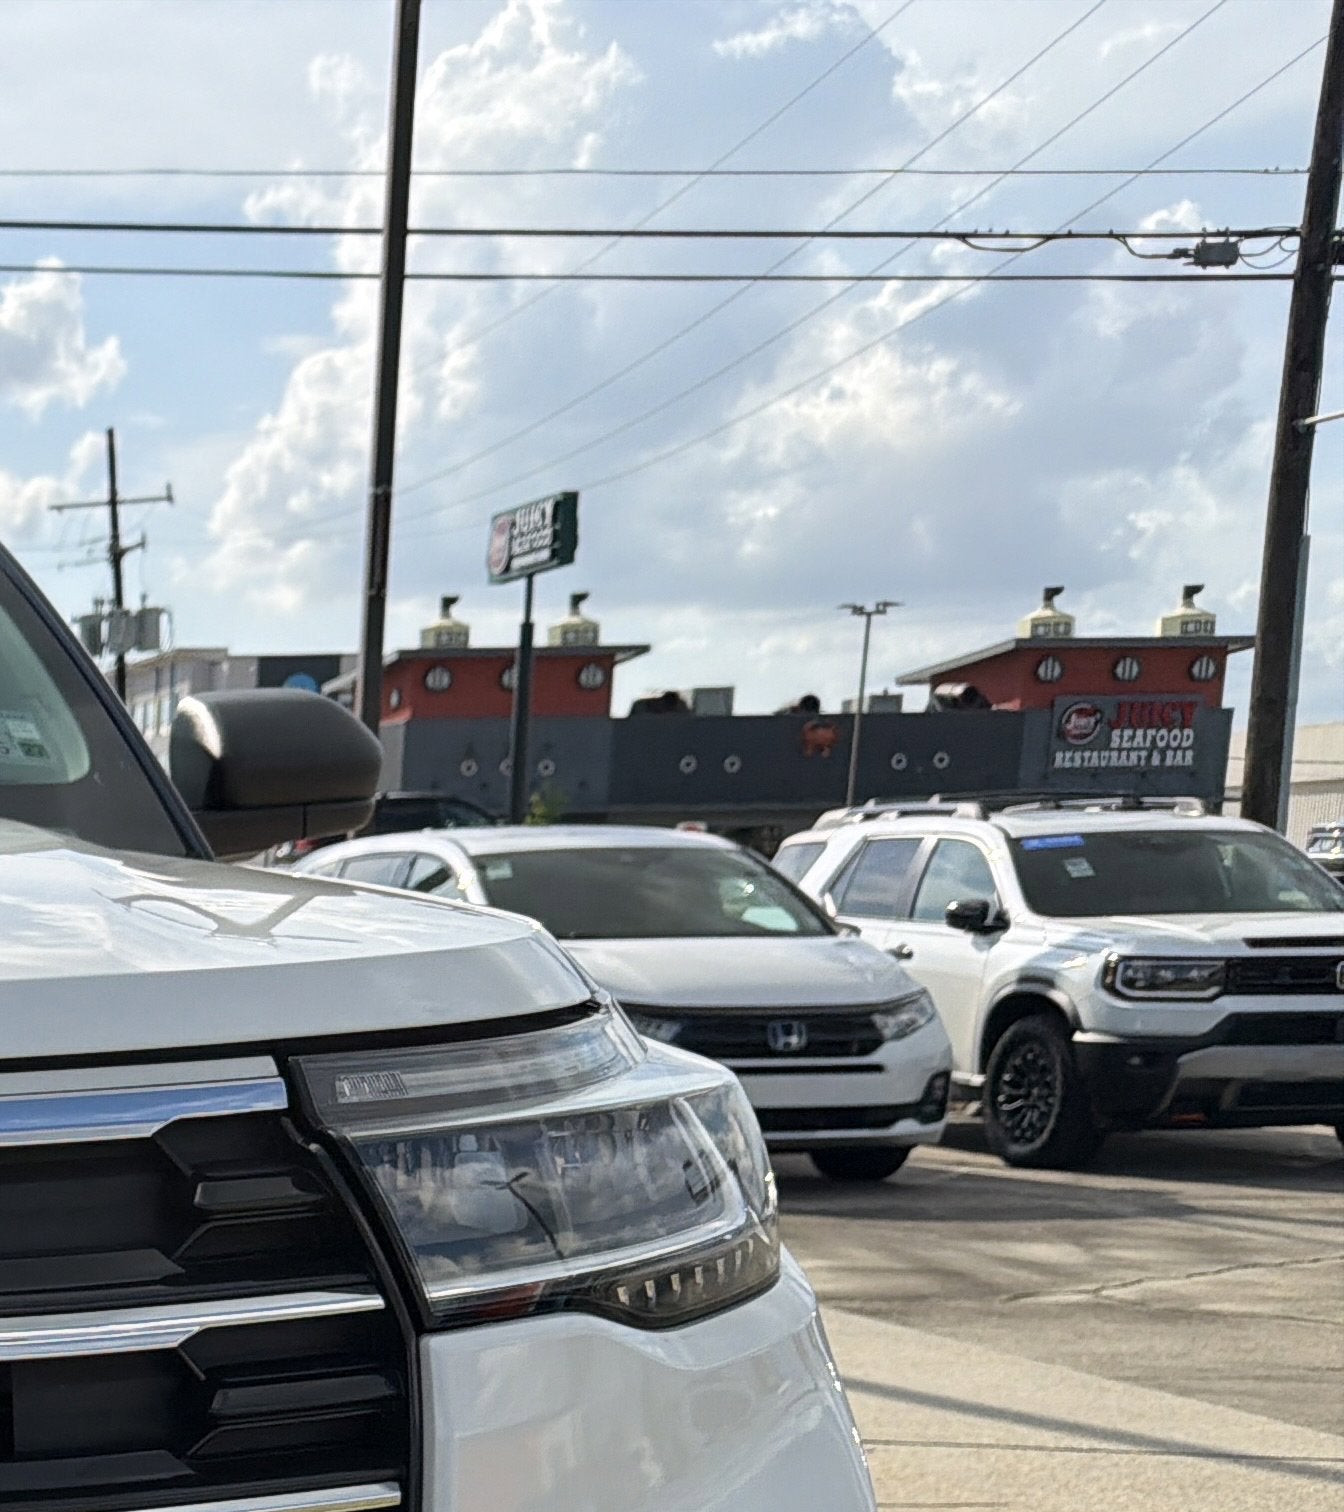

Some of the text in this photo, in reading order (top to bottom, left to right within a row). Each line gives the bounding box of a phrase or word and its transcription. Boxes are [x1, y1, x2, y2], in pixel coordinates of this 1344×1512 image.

[512, 498, 555, 535] JUICY
[1108, 701, 1198, 730] JUICY
[1110, 728, 1195, 749] SEAFOOD
[1053, 751, 1148, 769] RESTAURANT
[1164, 751, 1194, 767] BAR
